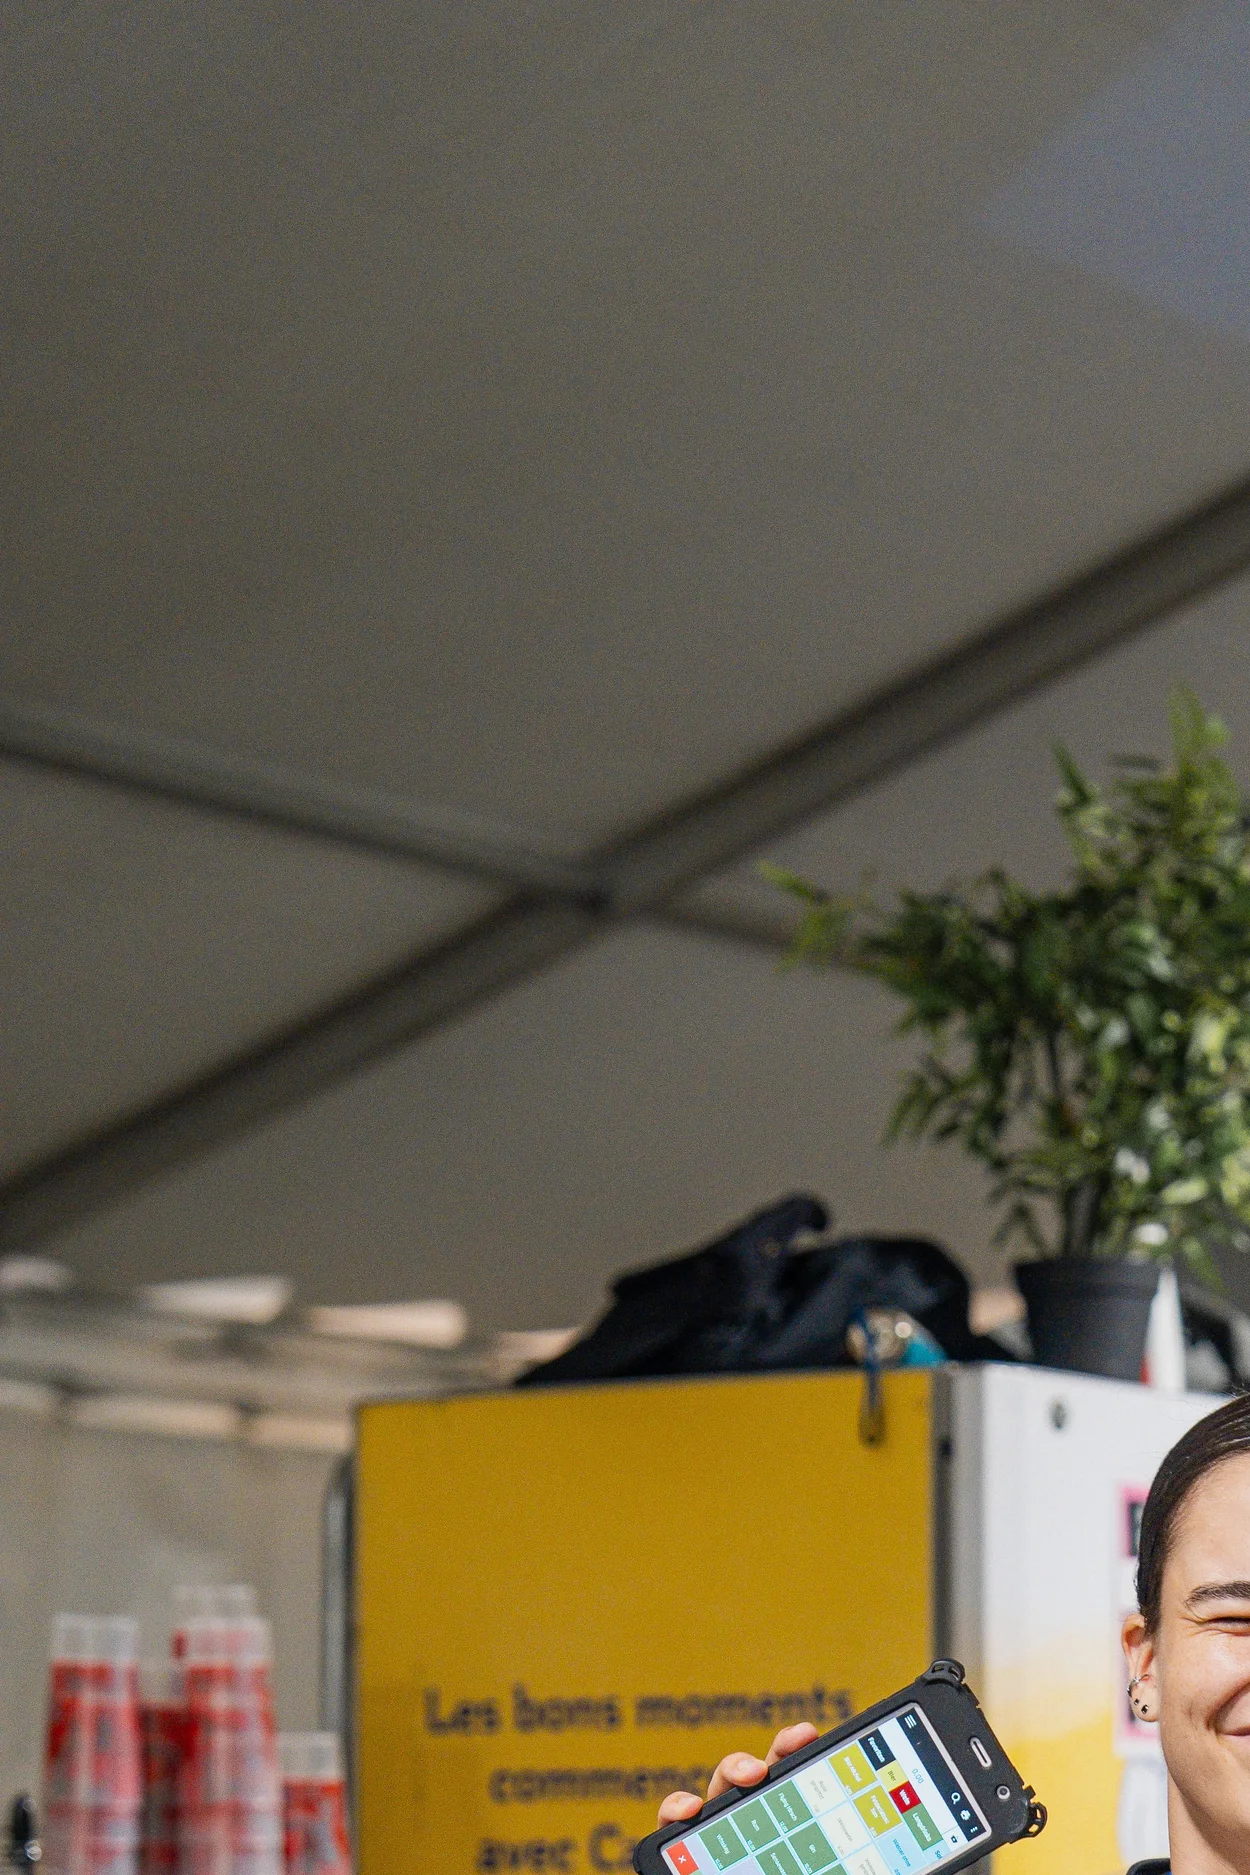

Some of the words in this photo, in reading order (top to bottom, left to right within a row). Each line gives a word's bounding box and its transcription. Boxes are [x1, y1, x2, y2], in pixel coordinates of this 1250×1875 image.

[423, 1685, 498, 1735] Les
[512, 1681, 620, 1732] bons
[636, 1682, 854, 1728] moments
[867, 1736, 885, 1762] Favoriten
[489, 1765, 714, 1802] commenc
[887, 1770, 896, 1781] Bier
[911, 1768, 924, 1784] 0.00
[777, 1792, 789, 1807] Flying
[785, 1805, 797, 1820] Hirsch
[898, 1789, 911, 1805] Wein
[750, 1819, 760, 1831] Rum
[911, 1812, 932, 1842] Longdrinks
[478, 1836, 576, 1874] avec
[715, 1833, 730, 1854] Whiskey
[808, 1844, 816, 1853] Gin
